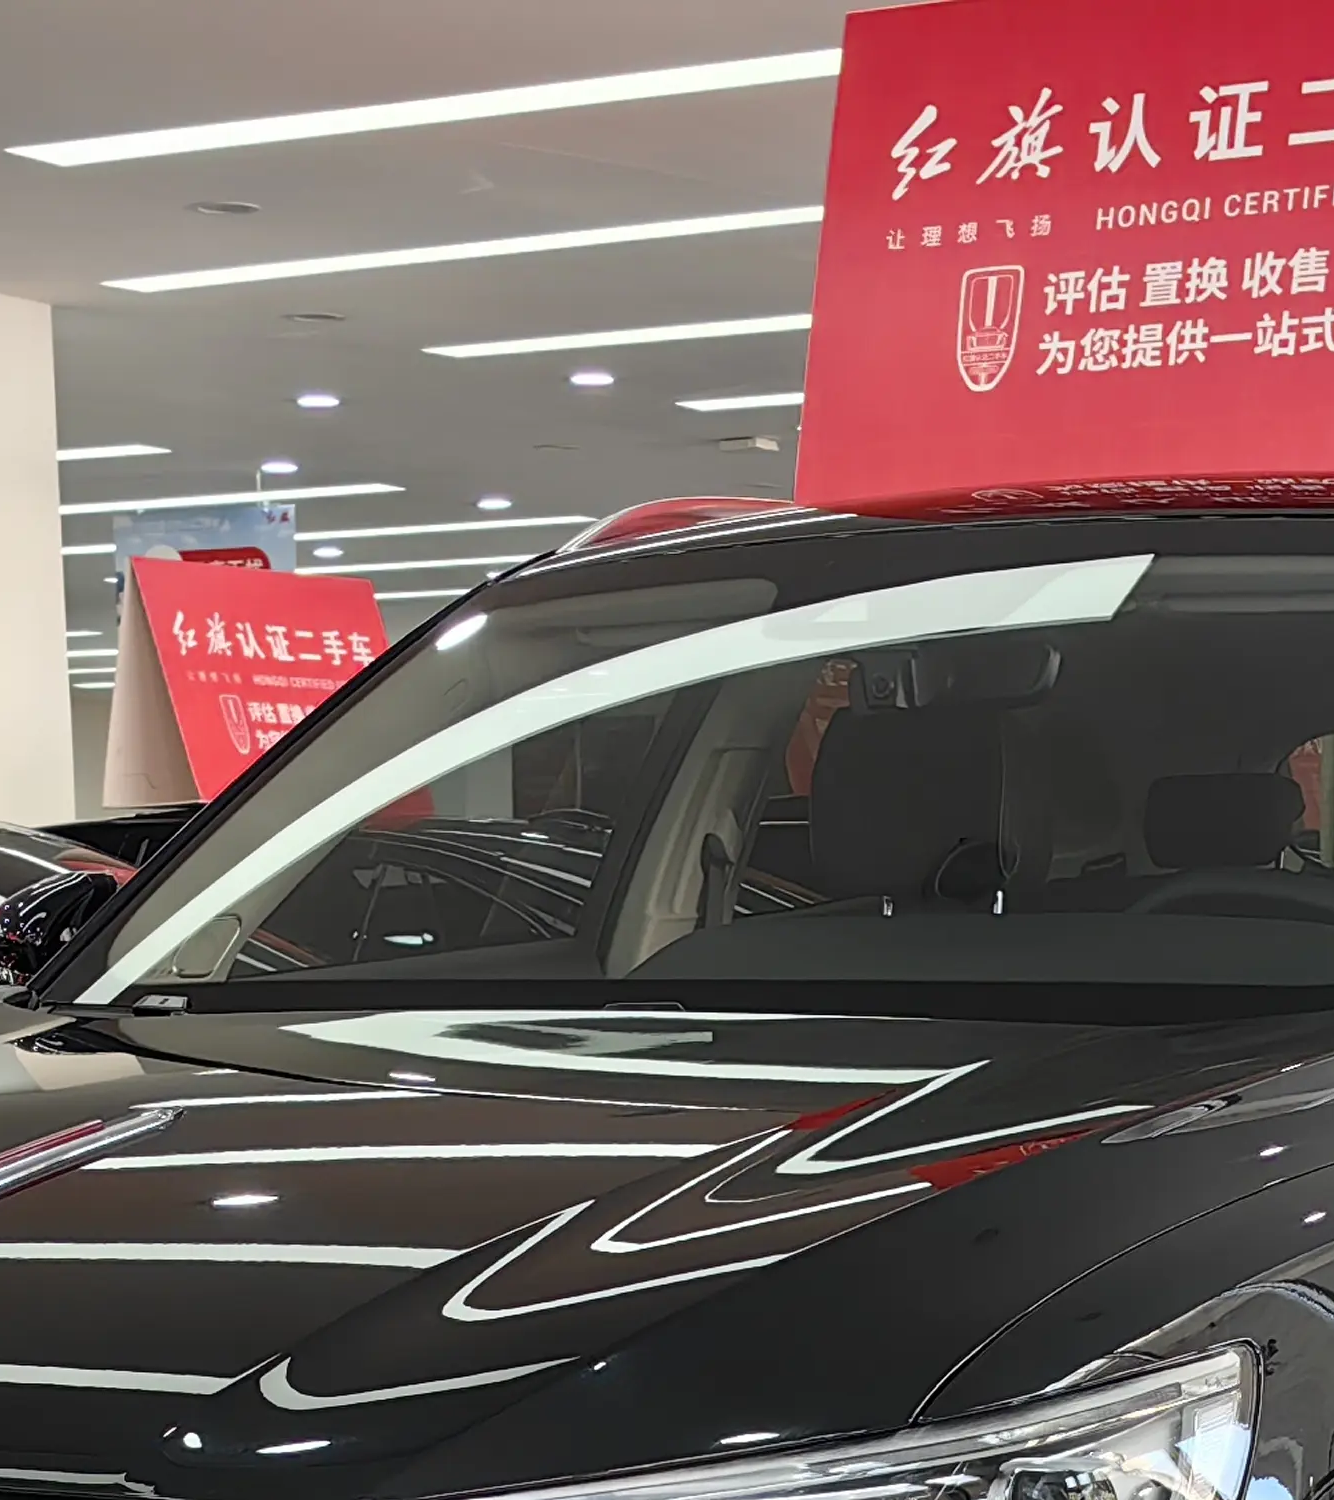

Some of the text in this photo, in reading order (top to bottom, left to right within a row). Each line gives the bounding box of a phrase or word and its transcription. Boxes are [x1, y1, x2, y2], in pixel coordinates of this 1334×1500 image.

[1096, 197, 1210, 230] HONGQI
[886, 215, 1051, 249] 让理想飞扬
[1044, 266, 1130, 315] 评估
[1140, 257, 1228, 306] 置换
[1242, 247, 1329, 298] 收售
